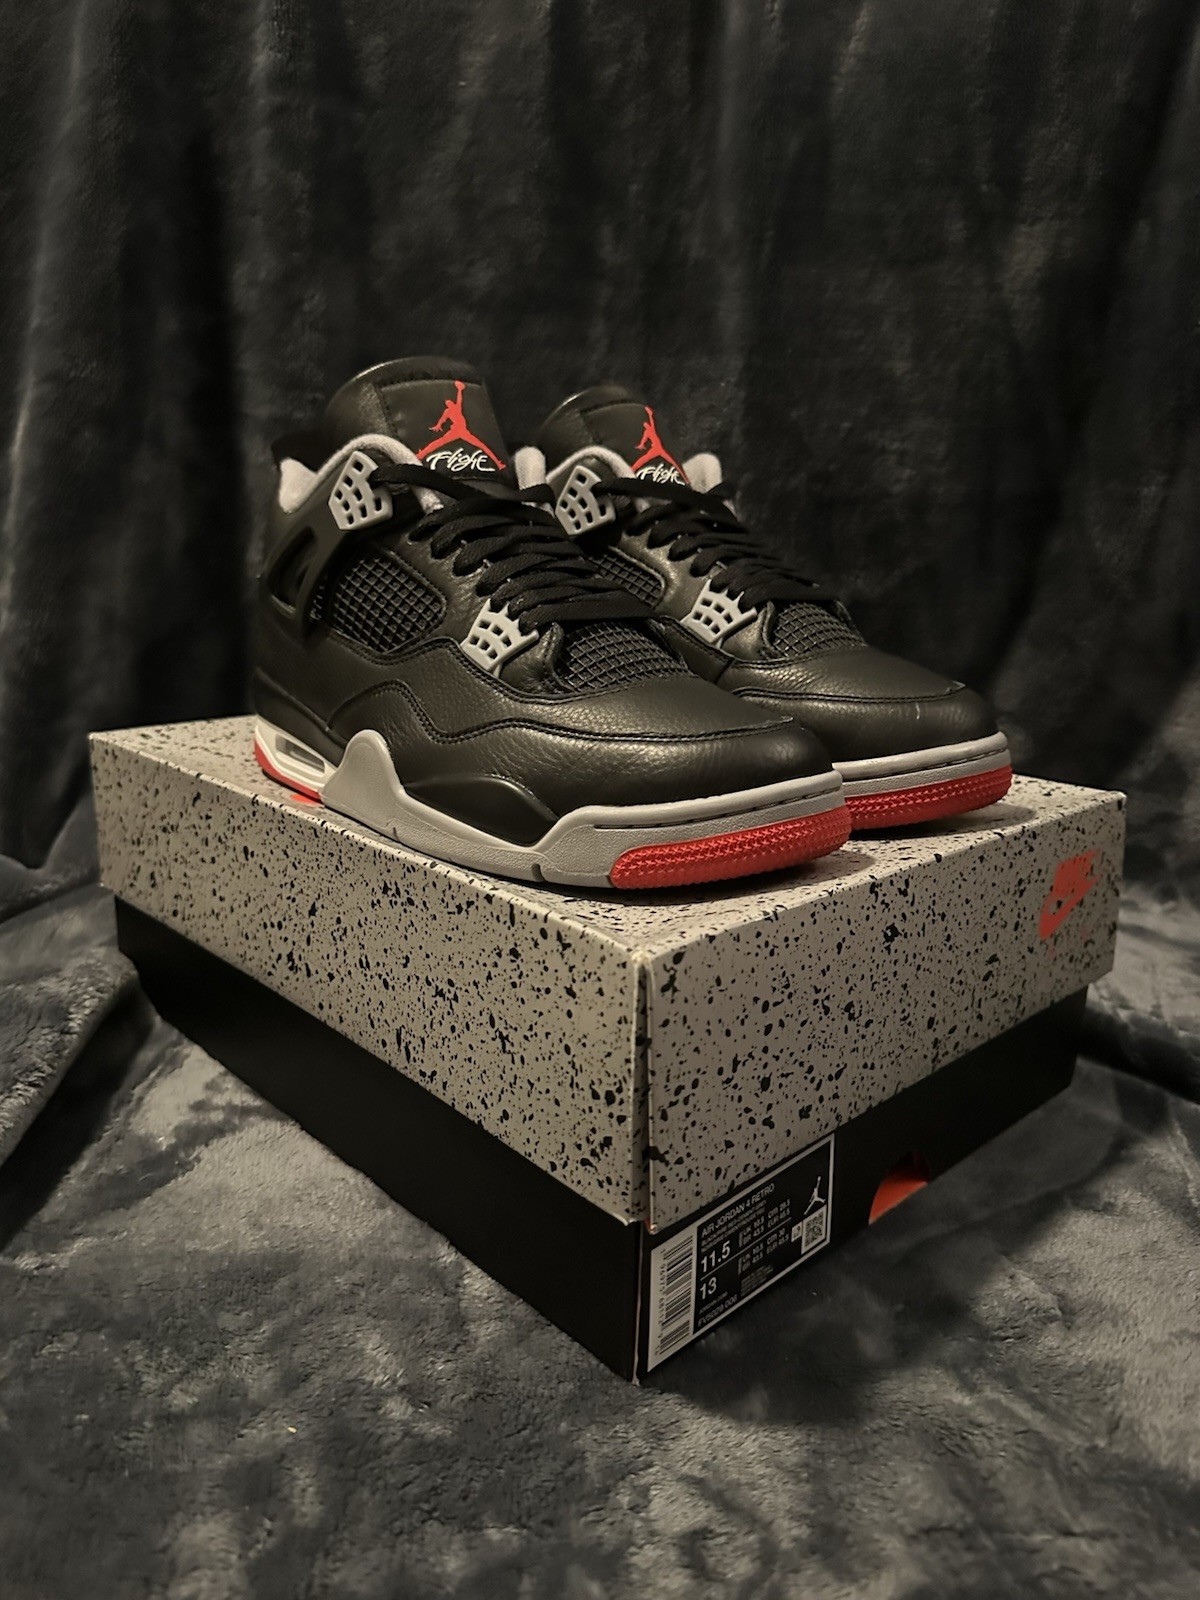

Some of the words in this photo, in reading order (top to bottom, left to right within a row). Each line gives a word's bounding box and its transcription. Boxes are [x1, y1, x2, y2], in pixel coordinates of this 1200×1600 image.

[426, 447, 496, 472] Flight
[636, 462, 685, 486] Flight
[701, 1222, 715, 1238] AIR
[715, 1202, 745, 1228] JORDAN
[751, 1183, 775, 1204] RETRO
[700, 1240, 731, 1273] 11.5
[699, 1277, 717, 1299] 13
